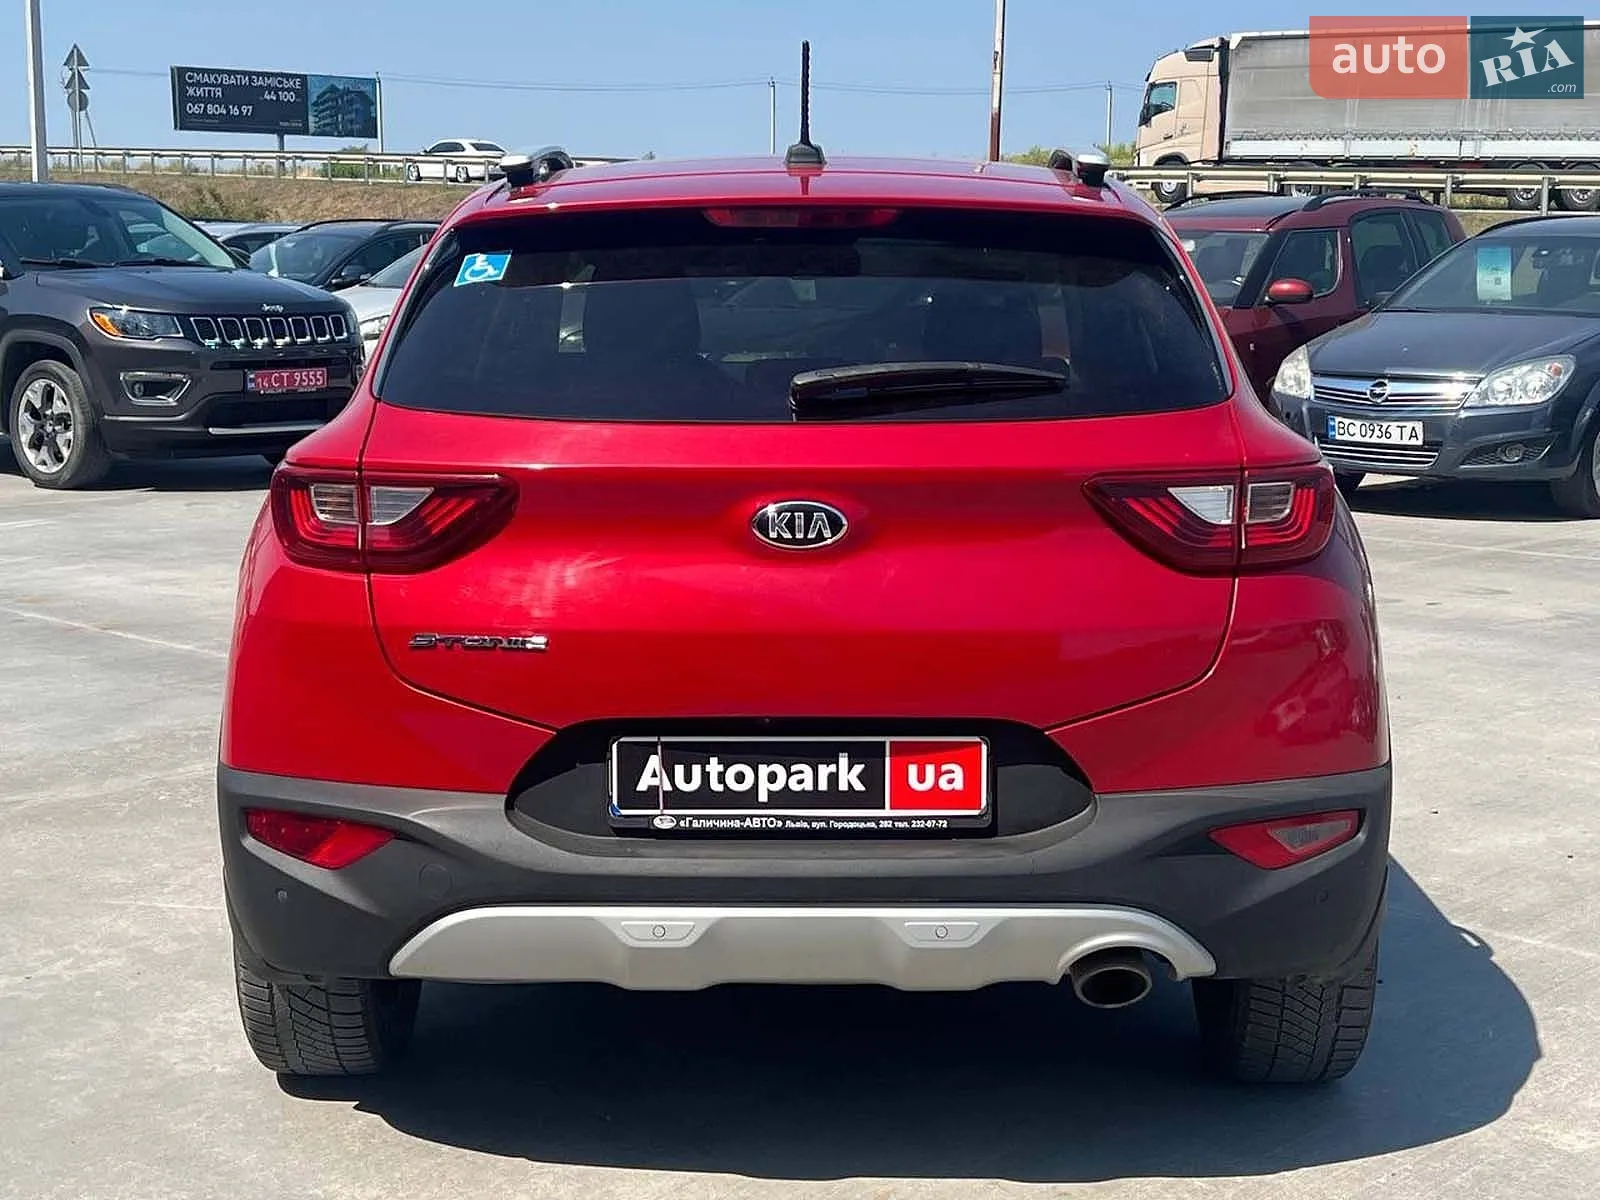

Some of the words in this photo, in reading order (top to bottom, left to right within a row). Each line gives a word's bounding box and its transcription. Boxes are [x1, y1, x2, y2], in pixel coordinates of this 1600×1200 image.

[185, 71, 250, 86] СМАКУВАТИ
[251, 77, 302, 90] ЗАМІСЬКЕ
[186, 87, 222, 99] ЖИТТЯ
[264, 90, 277, 101] 44
[278, 91, 296, 102] 100
[186, 103, 205, 114] 067
[207, 104, 227, 115] 804
[229, 105, 240, 116] 16
[241, 105, 253, 117] 97
[271, 372, 290, 387] CT
[294, 371, 324, 386] 9555
[1337, 420, 1356, 437] BC
[1359, 423, 1392, 440] 0936
[1396, 425, 1419, 441] TA
[768, 511, 832, 539] KIA
[636, 752, 867, 802] Autopark
[907, 761, 965, 792] ua
[679, 817, 783, 829] «Галичина-АВТО»
